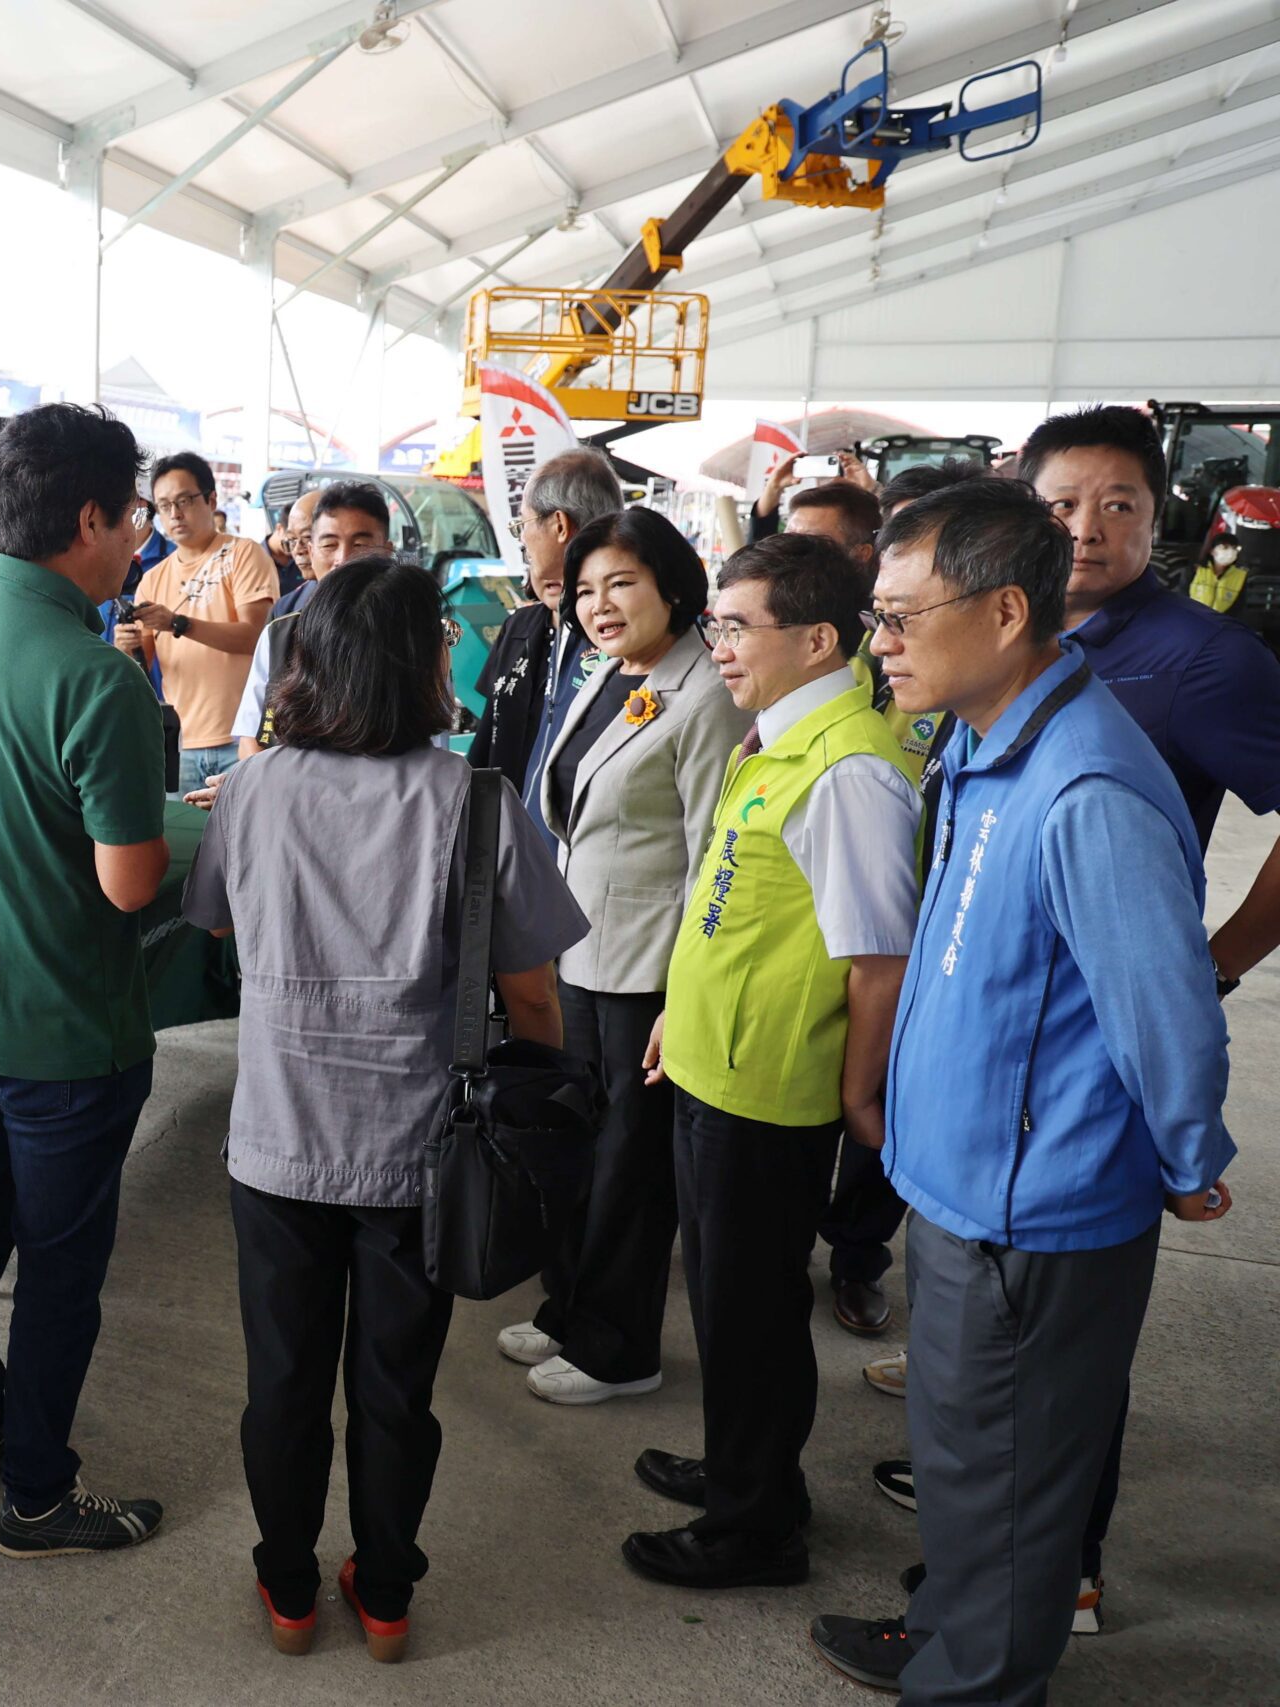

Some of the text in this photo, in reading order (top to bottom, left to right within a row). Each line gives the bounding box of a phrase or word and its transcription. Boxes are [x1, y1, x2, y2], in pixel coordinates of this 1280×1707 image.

[628, 393, 699, 415] JCB
[699, 828, 739, 940] 農糧署
[940, 809, 997, 977] 雲林縣政府
